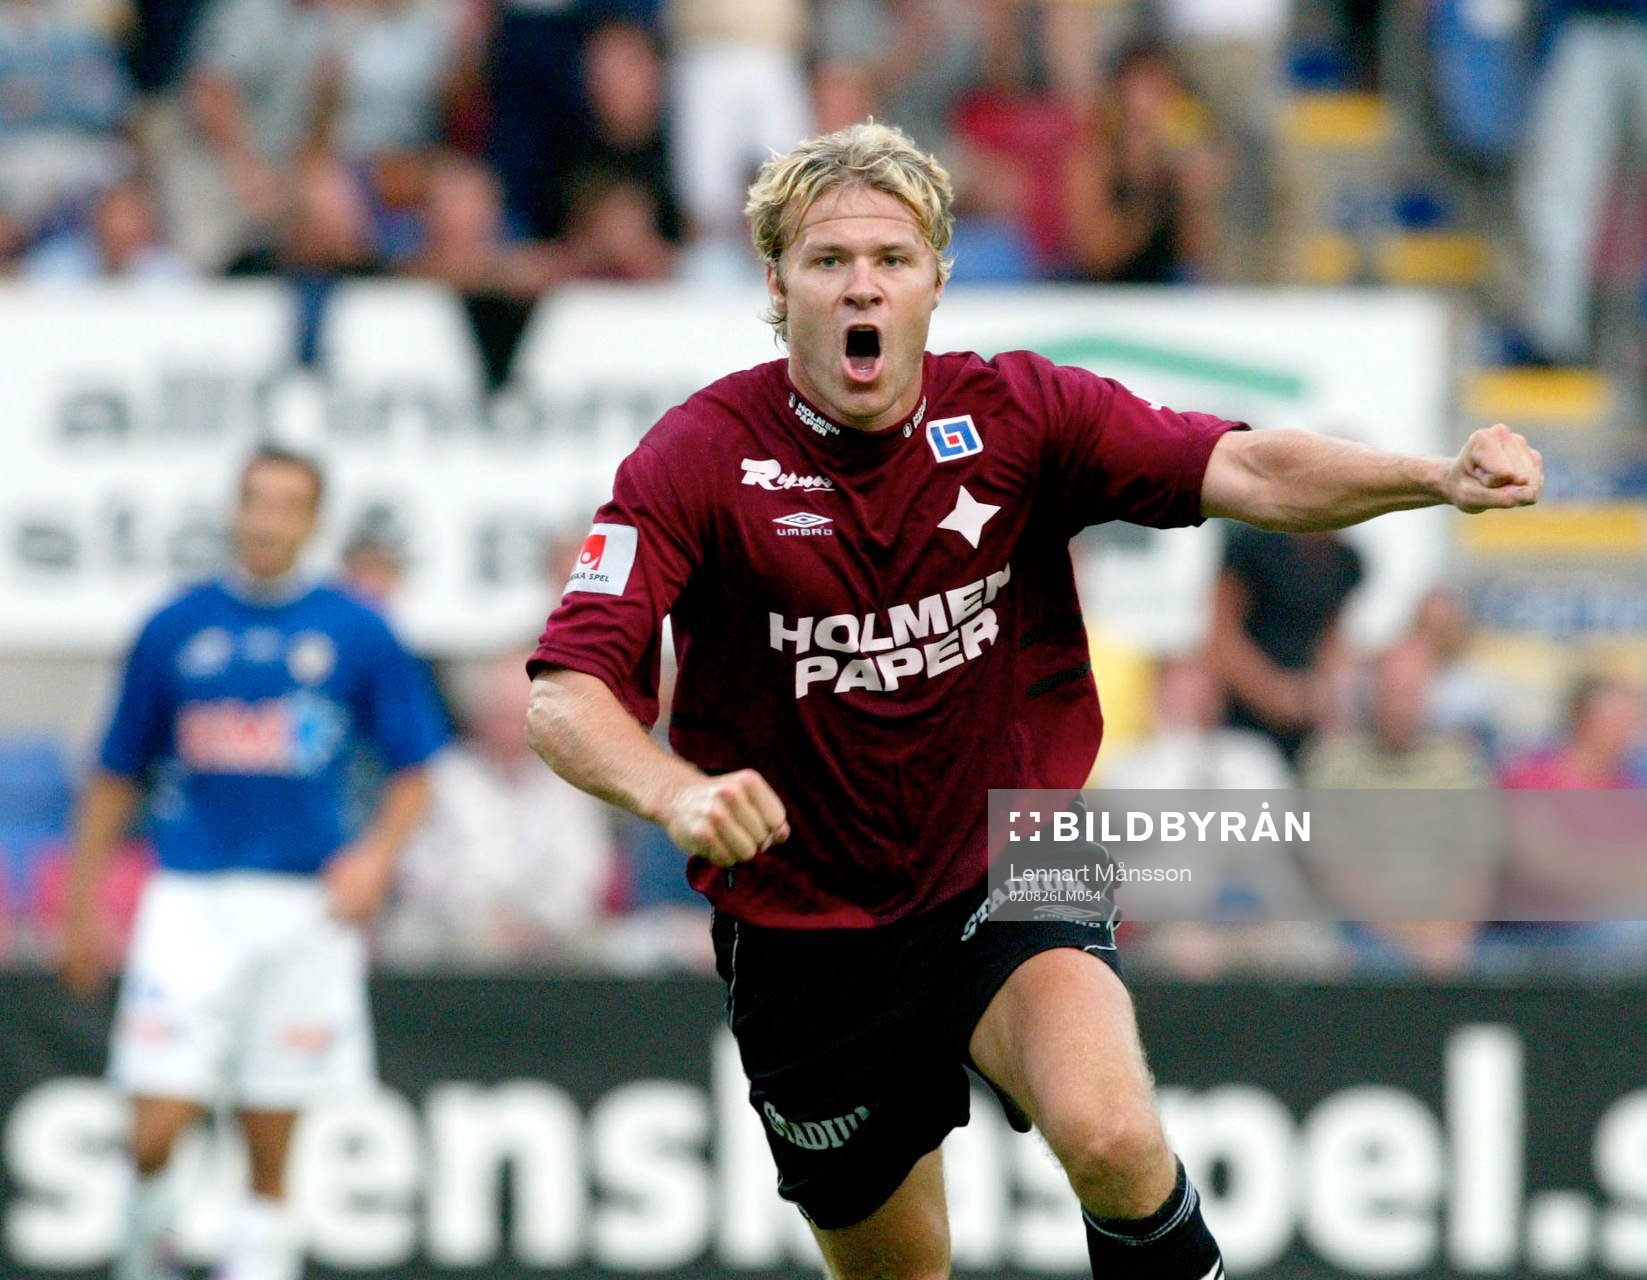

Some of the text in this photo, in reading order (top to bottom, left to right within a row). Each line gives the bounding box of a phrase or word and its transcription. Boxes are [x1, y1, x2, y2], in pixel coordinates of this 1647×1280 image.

[794, 408, 828, 437] PAPER
[797, 401, 840, 436] HOLMEN
[588, 573, 610, 583] SPEL
[769, 561, 1011, 655] HOLMEN
[795, 608, 1000, 700] PAPER
[763, 1101, 871, 1151] STADIU
